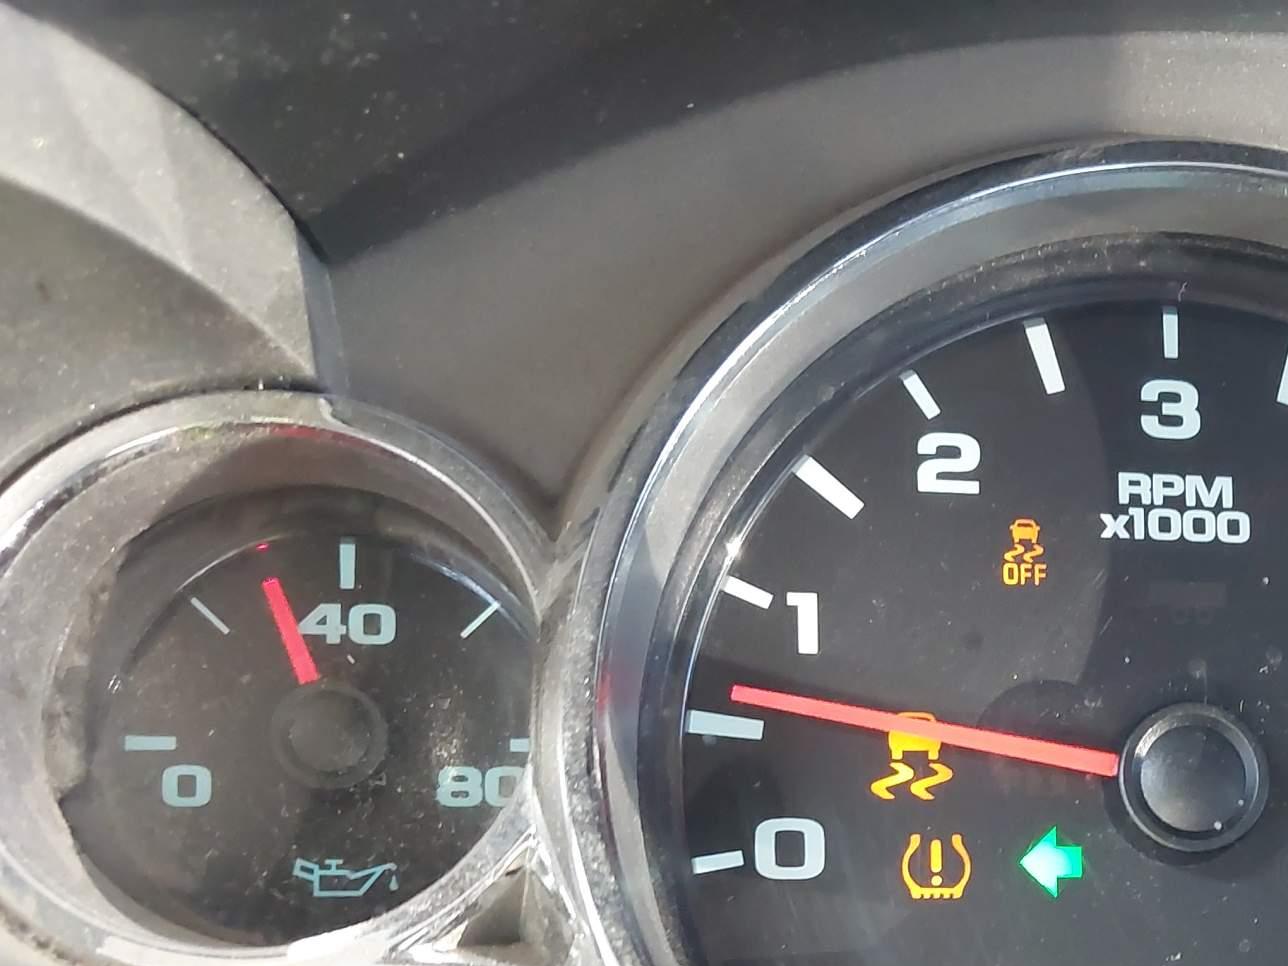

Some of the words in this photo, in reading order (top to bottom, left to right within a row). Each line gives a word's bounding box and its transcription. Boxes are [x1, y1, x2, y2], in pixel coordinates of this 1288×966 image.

[1140, 379, 1201, 440] 3
[917, 432, 981, 495] 2
[1117, 471, 1233, 509] RPM
[1100, 509, 1251, 544] x1000
[1002, 563, 1047, 586] OFF
[297, 603, 396, 645] 40
[786, 592, 819, 655] 1
[161, 764, 212, 807] 0
[754, 817, 826, 880] 0
